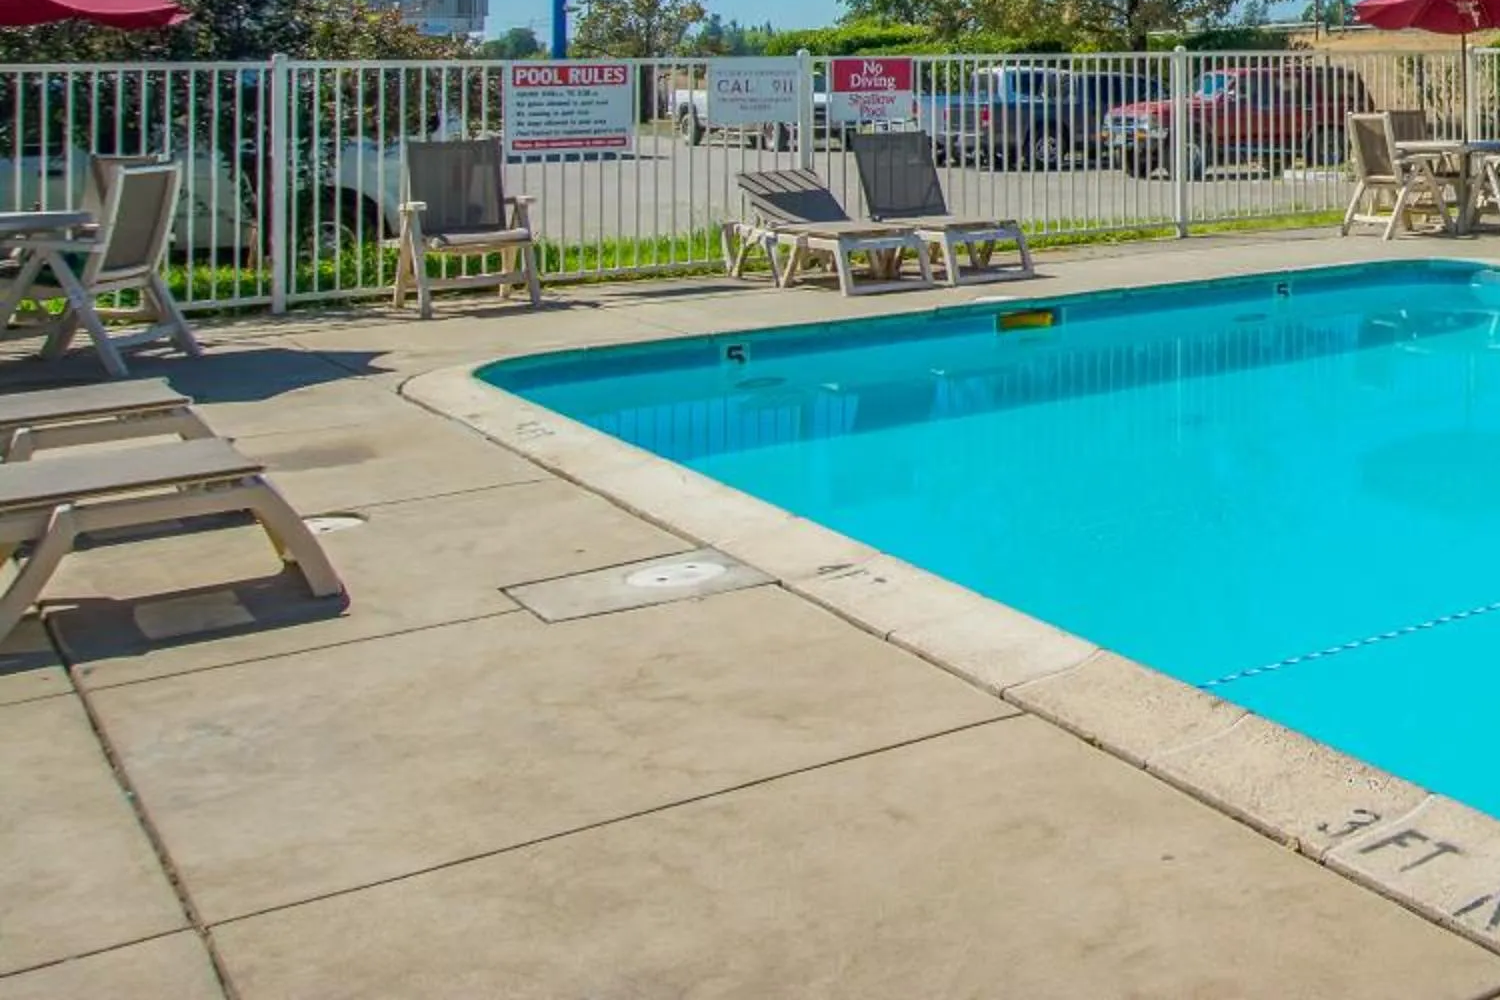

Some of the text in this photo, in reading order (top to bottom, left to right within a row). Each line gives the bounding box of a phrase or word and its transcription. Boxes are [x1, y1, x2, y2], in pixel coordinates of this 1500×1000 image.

[515, 67, 625, 85] POOL RULES
[862, 60, 884, 77] No
[850, 73, 897, 91] Diving
[727, 342, 745, 365] 5
[1357, 828, 1461, 873] FT
